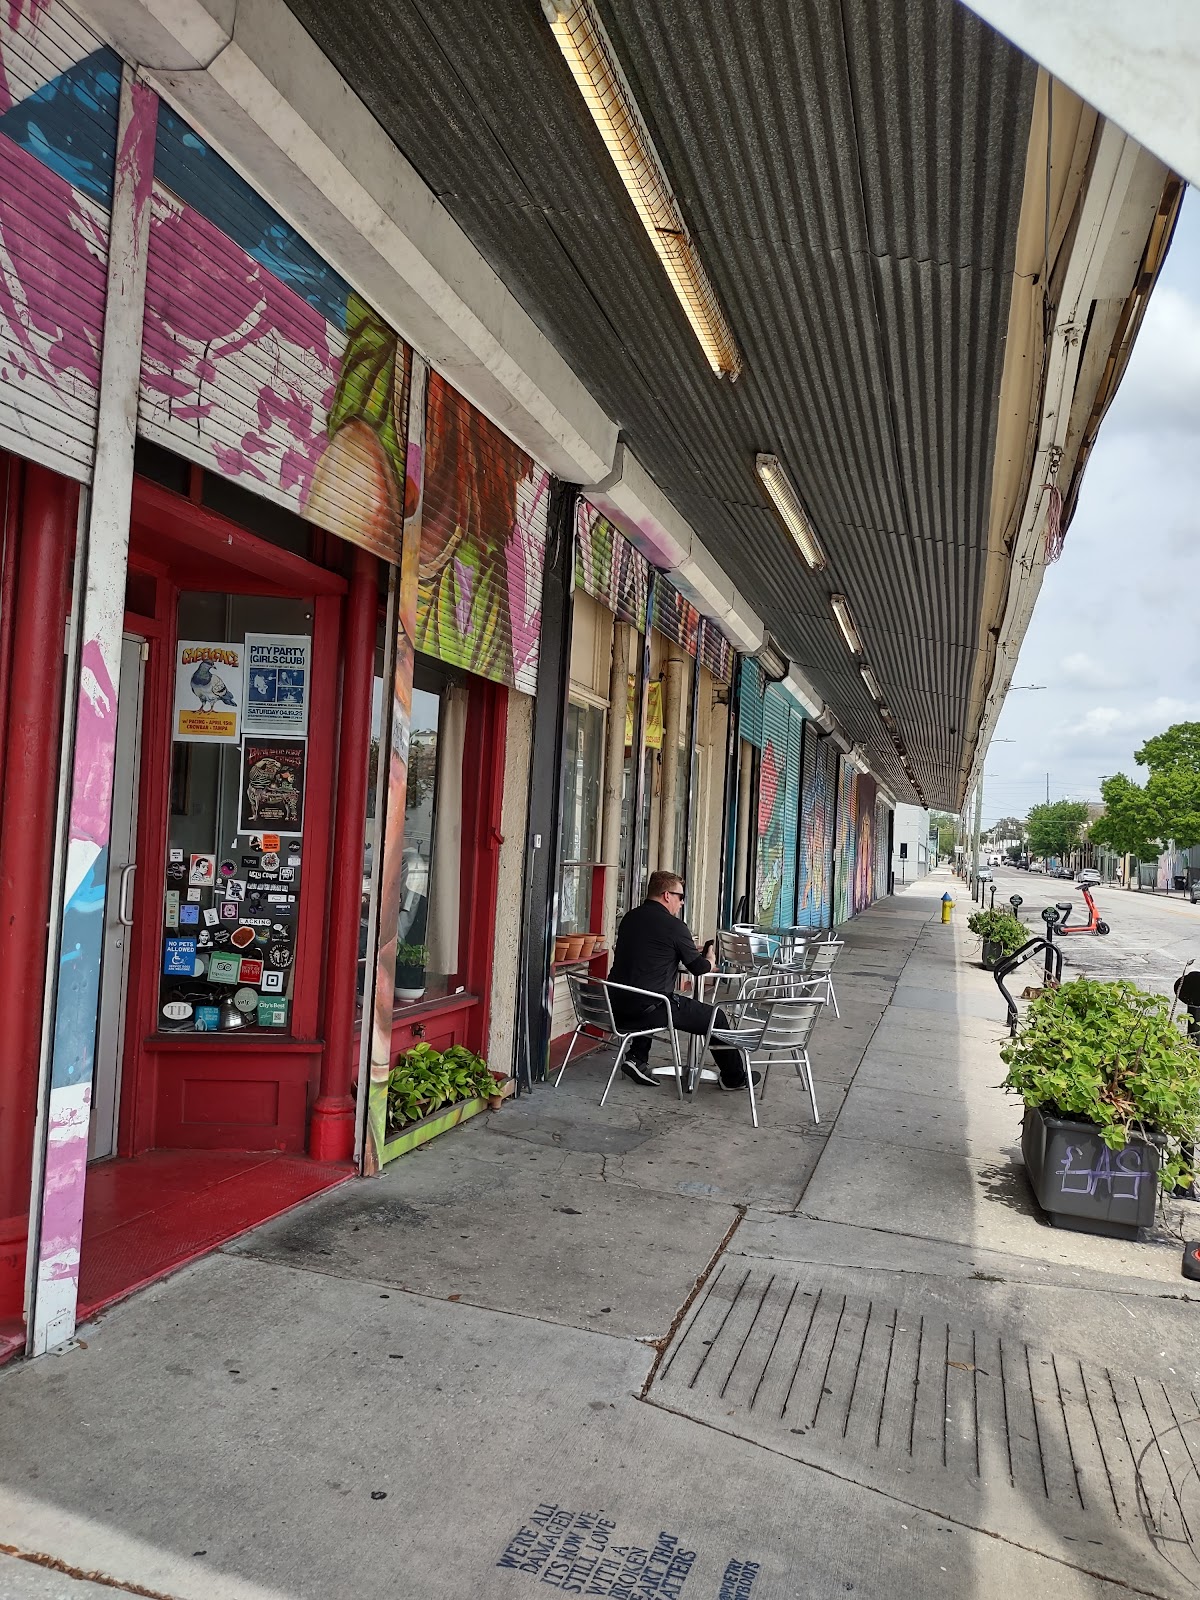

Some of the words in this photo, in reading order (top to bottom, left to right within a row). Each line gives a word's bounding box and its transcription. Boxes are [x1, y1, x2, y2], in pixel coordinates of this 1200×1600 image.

[250, 646, 272, 655] PITY
[273, 647, 305, 656] PARTY
[250, 654, 278, 664] (GIRLS
[279, 656, 305, 665] CLUB)
[248, 708, 279, 716] SATURDAY
[167, 1005, 188, 1016] TH
[529, 1503, 558, 1527] ALL
[556, 1531, 586, 1562] HOW
[574, 1510, 599, 1530] WE
[561, 1556, 599, 1594] STILL
[586, 1518, 617, 1553] LOVE
[585, 1558, 621, 1595] WITH
[611, 1545, 630, 1557] A
[608, 1546, 649, 1600] BROKEN
[629, 1565, 665, 1600] EART
[650, 1531, 679, 1565] THAT
[656, 1548, 697, 1600] ATTERS
